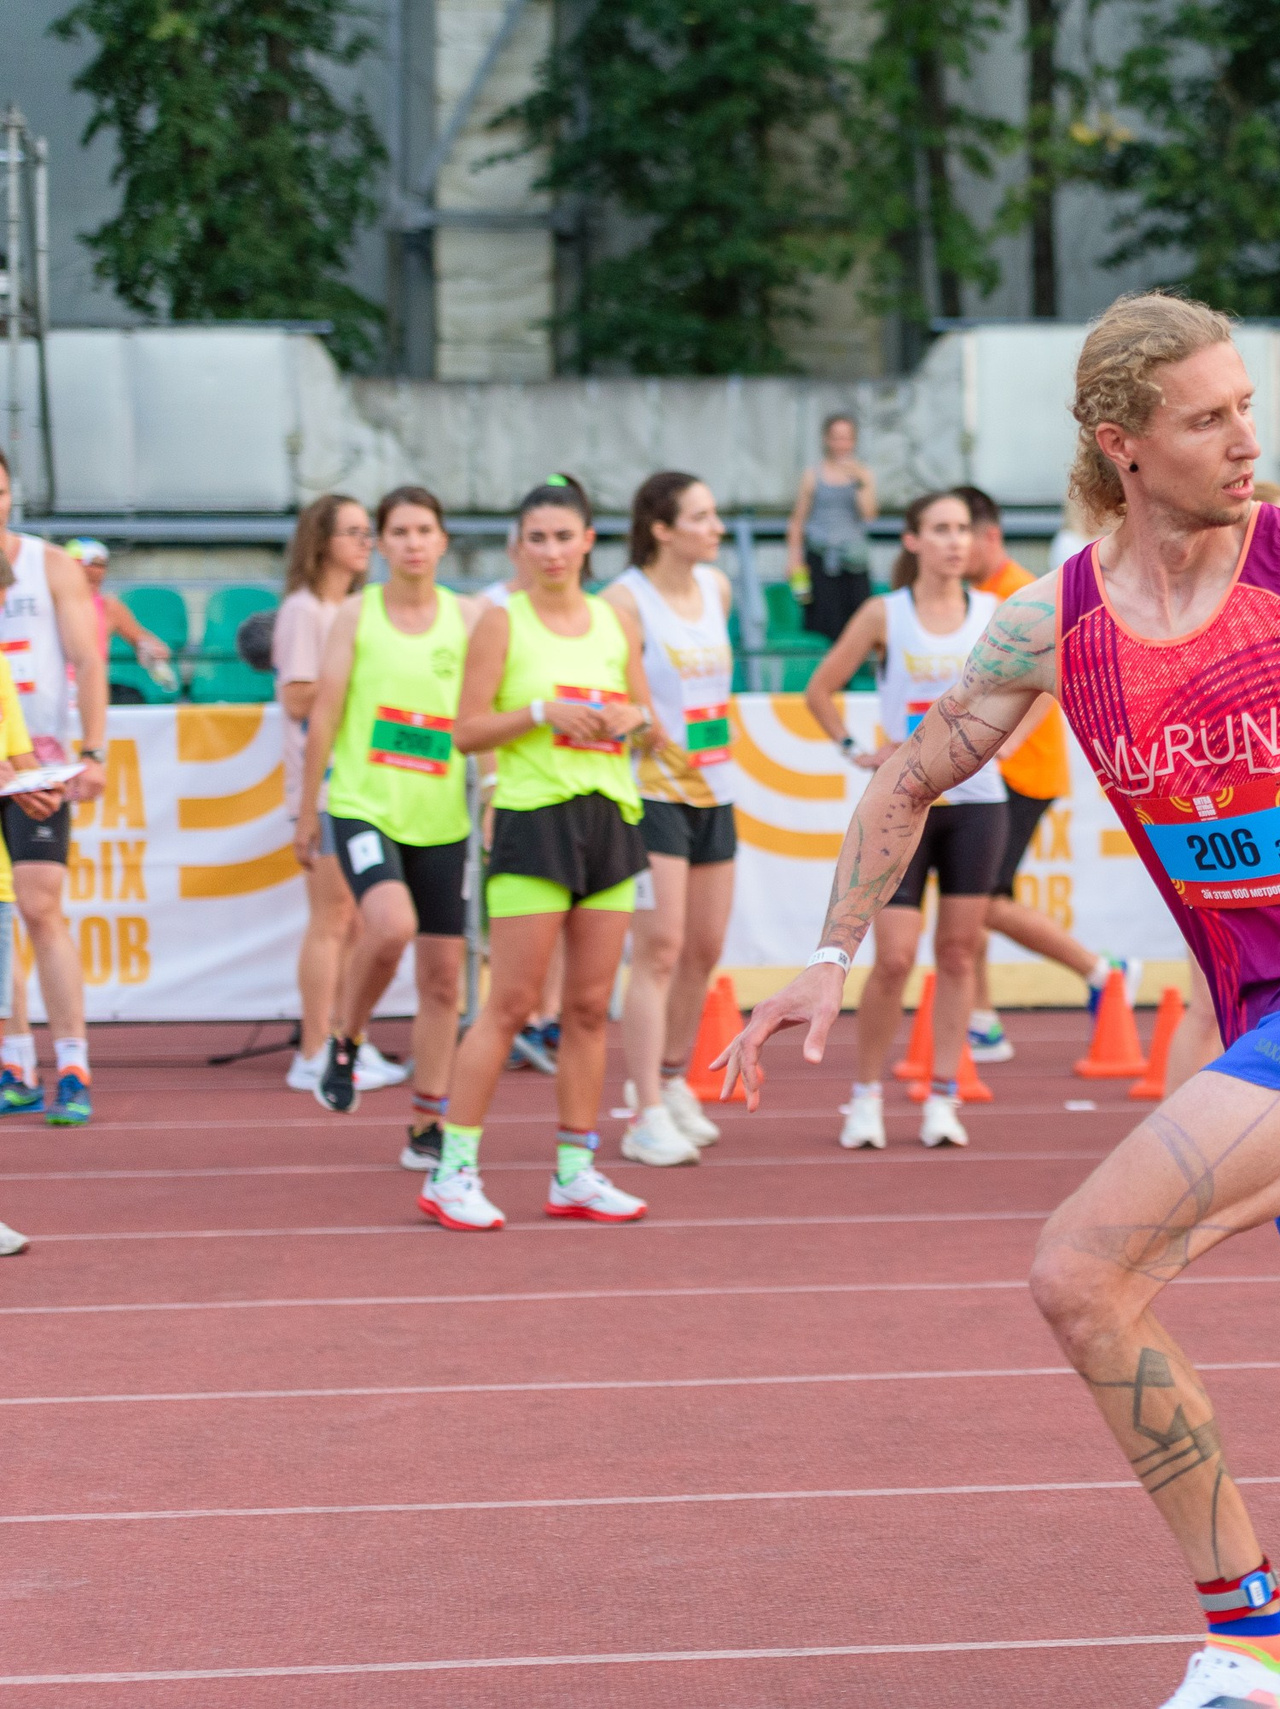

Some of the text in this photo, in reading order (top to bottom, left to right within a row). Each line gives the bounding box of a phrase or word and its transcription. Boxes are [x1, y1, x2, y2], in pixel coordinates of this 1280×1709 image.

[1186, 828, 1261, 871] 206
[1213, 889, 1233, 900] этап
[1232, 887, 1250, 899] 800
